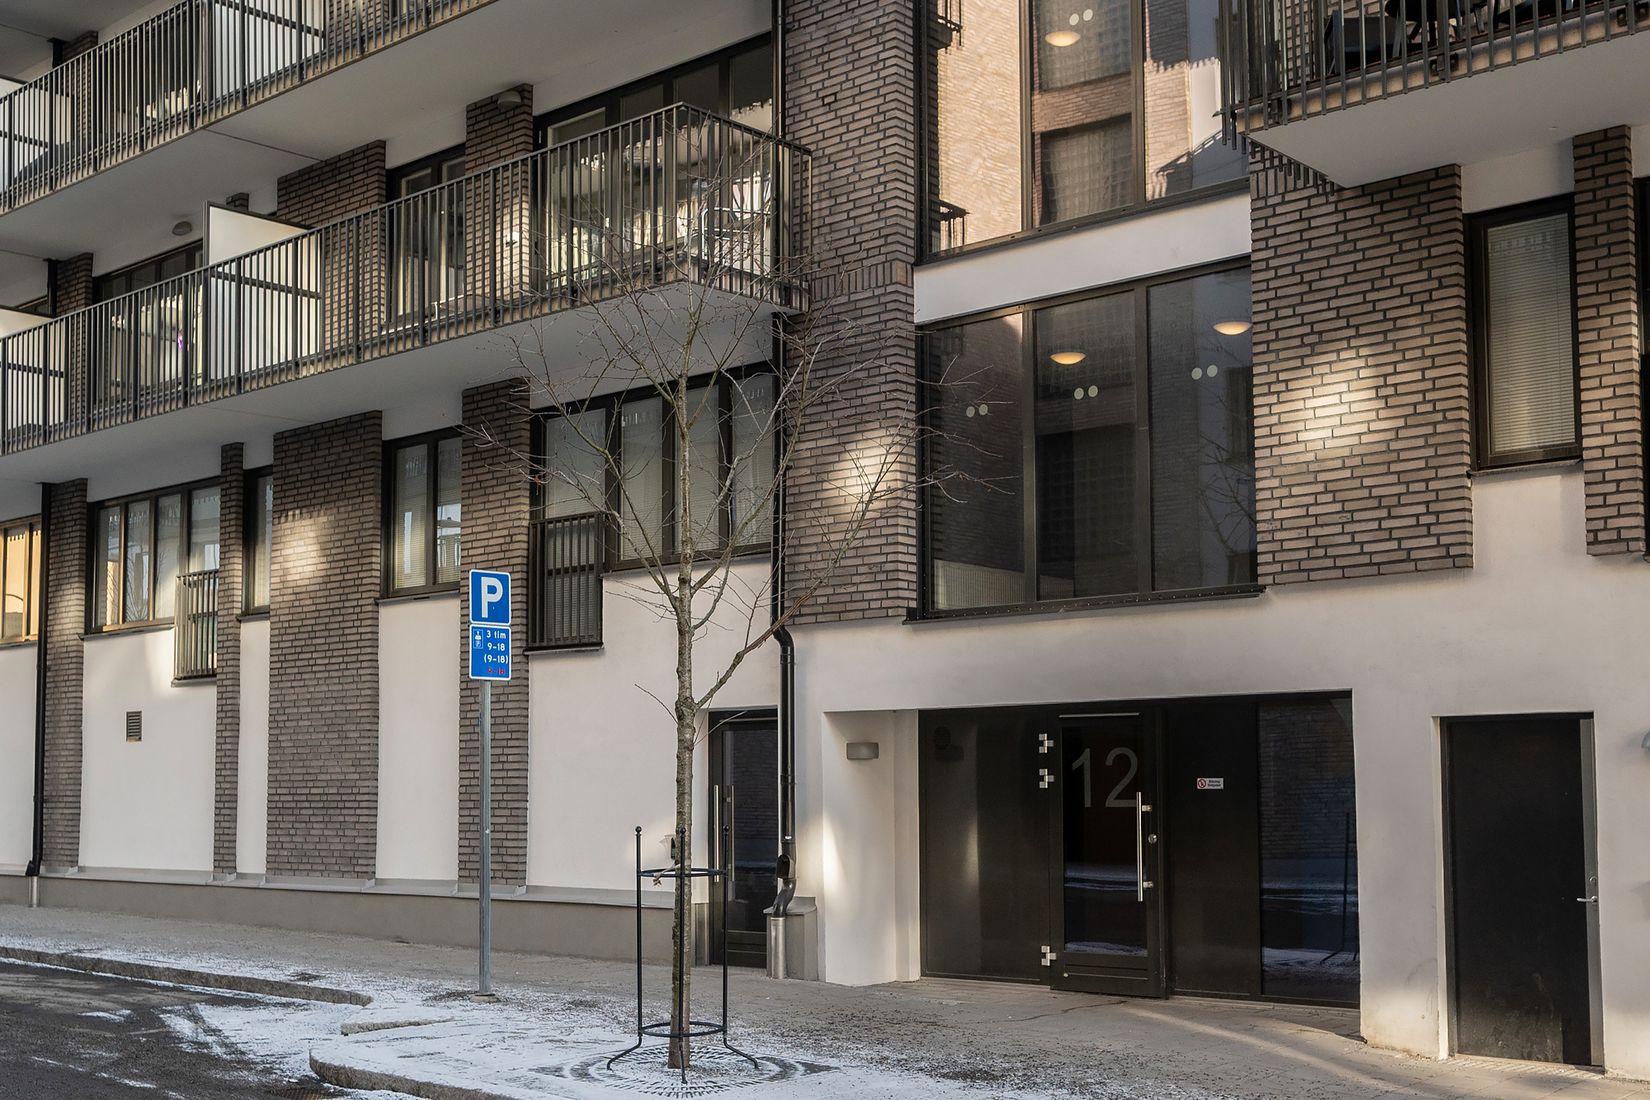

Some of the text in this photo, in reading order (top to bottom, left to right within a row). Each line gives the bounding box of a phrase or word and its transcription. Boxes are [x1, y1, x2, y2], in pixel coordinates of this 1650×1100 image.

[481, 577, 503, 618] P
[486, 630, 506, 639] 3 tim
[487, 642, 505, 651] 9-18
[484, 654, 508, 664] (9-18)
[1071, 747, 1139, 808] 12
